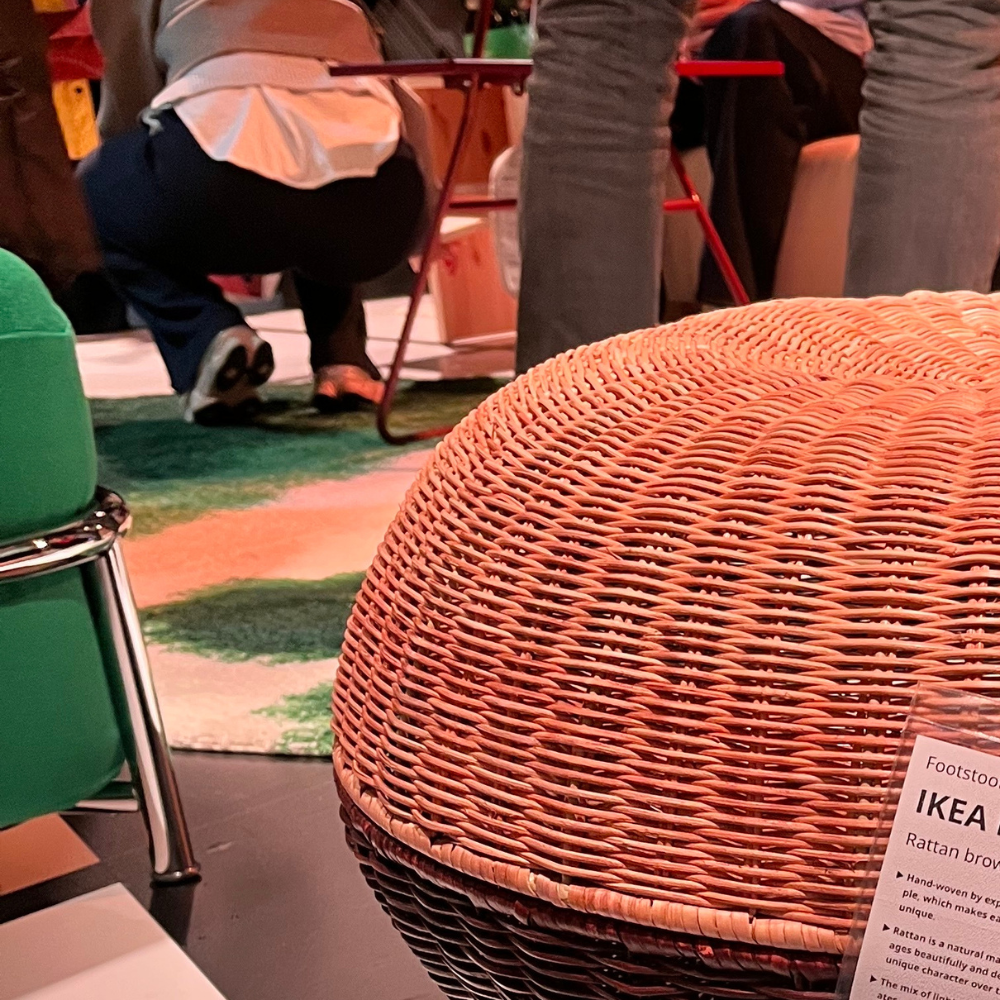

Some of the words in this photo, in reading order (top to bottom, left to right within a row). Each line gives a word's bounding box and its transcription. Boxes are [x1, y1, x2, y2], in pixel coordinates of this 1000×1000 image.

[916, 789, 986, 832] IKEA
[905, 832, 960, 860] Rattan
[906, 873, 968, 898] Hand-woven
[970, 891, 983, 903] by
[923, 895, 953, 910] which
[954, 904, 988, 919] makes
[888, 942, 912, 955] ages
[914, 948, 969, 972] beautifully
[969, 965, 989, 976] and
[893, 926, 926, 943] Rattan
[928, 936, 936, 946] is
[946, 943, 985, 960] natural
[880, 977, 898, 990] The
[899, 984, 919, 996] mix
[920, 990, 932, 1000] of
[885, 956, 920, 972] unique
[921, 966, 970, 985] character
[971, 981, 994, 992] over
